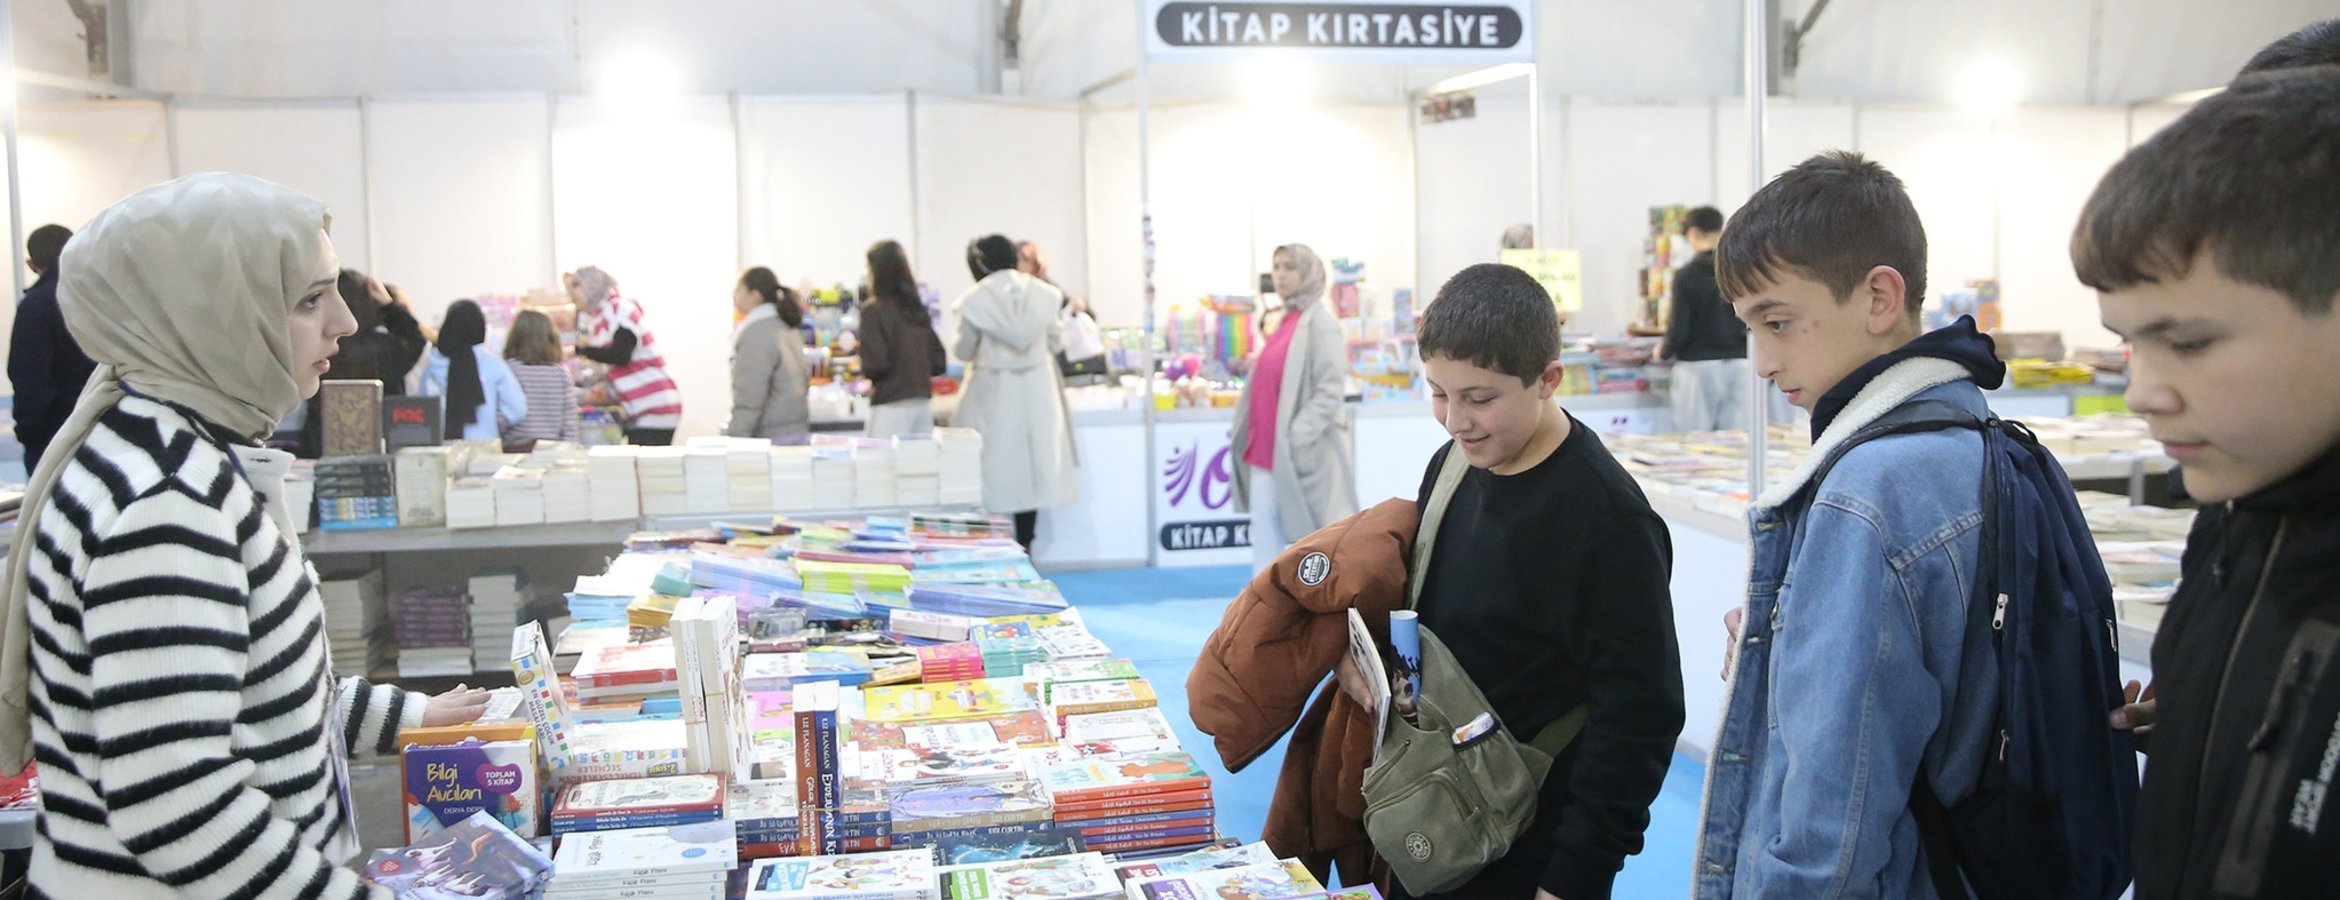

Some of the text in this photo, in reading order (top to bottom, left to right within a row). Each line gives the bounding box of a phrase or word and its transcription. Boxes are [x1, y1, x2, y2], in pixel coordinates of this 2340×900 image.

[1181, 5, 1500, 46] KİTAP KIRTASİYE
[1170, 524, 1225, 549] KİTAP
[802, 717, 811, 769] LIZ FLANAGAN
[822, 731, 832, 770] FLANAGAN
[426, 762, 458, 788] Bilgi
[485, 770, 517, 780] TOPLAM
[487, 777, 515, 787] 5 KİTAP
[426, 783, 483, 803] Avcıları
[443, 806, 466, 815] DERYA
